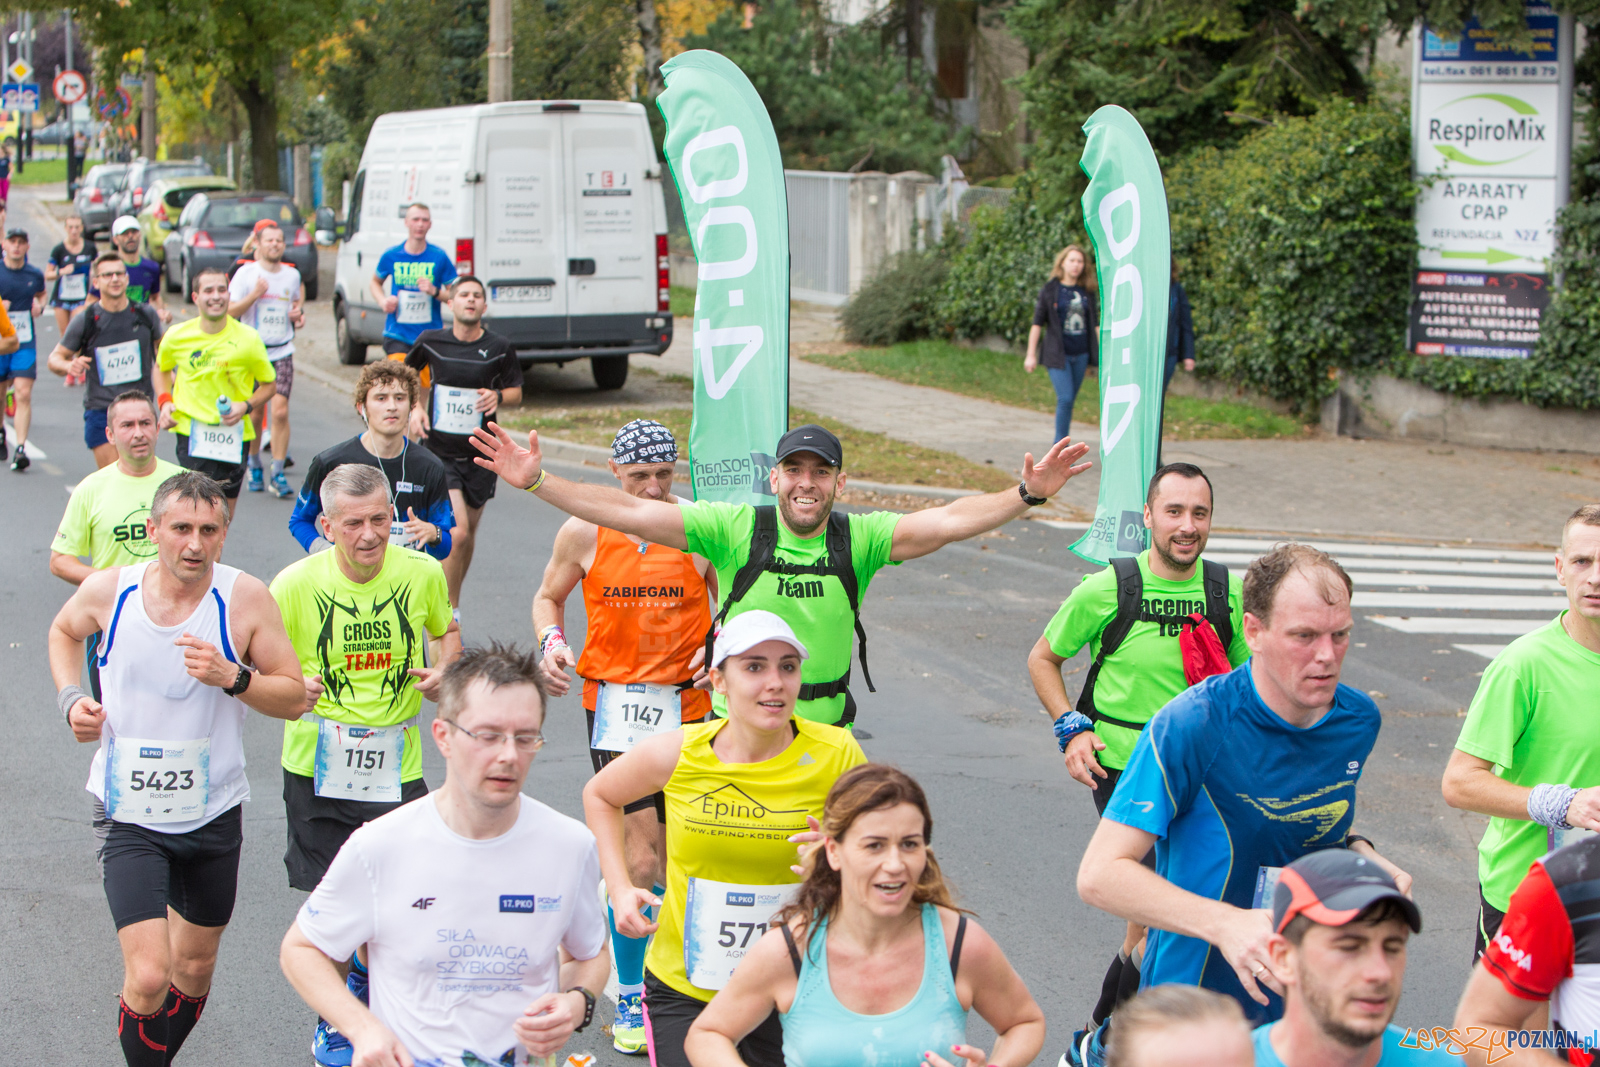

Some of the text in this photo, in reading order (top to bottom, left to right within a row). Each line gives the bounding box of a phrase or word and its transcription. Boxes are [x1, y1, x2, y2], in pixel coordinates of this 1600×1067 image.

[1429, 117, 1545, 147] RespiroMix
[1443, 182, 1527, 200] APARATY
[1461, 204, 1508, 220] CPAP
[1432, 228, 1503, 240] REFUNDACJA
[393, 262, 435, 276] START
[1419, 291, 1506, 304] AUTOELEKTRYK
[405, 301, 426, 310] 7277
[1424, 303, 1540, 318] AUTOELEKTRONIK
[1419, 315, 1468, 327] ALARMY,
[107, 354, 135, 368] 4749
[446, 402, 473, 415] 1145
[203, 431, 234, 444] 1806
[638, 443, 673, 457] SCOUT
[113, 523, 148, 542] SB
[602, 586, 684, 598] ZABIEGANI
[777, 576, 824, 598] Team
[343, 620, 391, 641] CROSS
[344, 652, 392, 671] TEAM
[621, 703, 663, 726] 1147
[628, 722, 655, 732] BOGDAN
[345, 748, 385, 769] 1151
[130, 769, 194, 791] 5423
[702, 796, 765, 819] Epino
[684, 824, 791, 841] WWW.EPINO-KOSCIA
[436, 929, 476, 943] SIŁA
[717, 921, 770, 948] 571
[449, 944, 529, 960] ODWAGA
[725, 950, 748, 958] AGN
[436, 960, 528, 975] SZYBKOŚĆ
